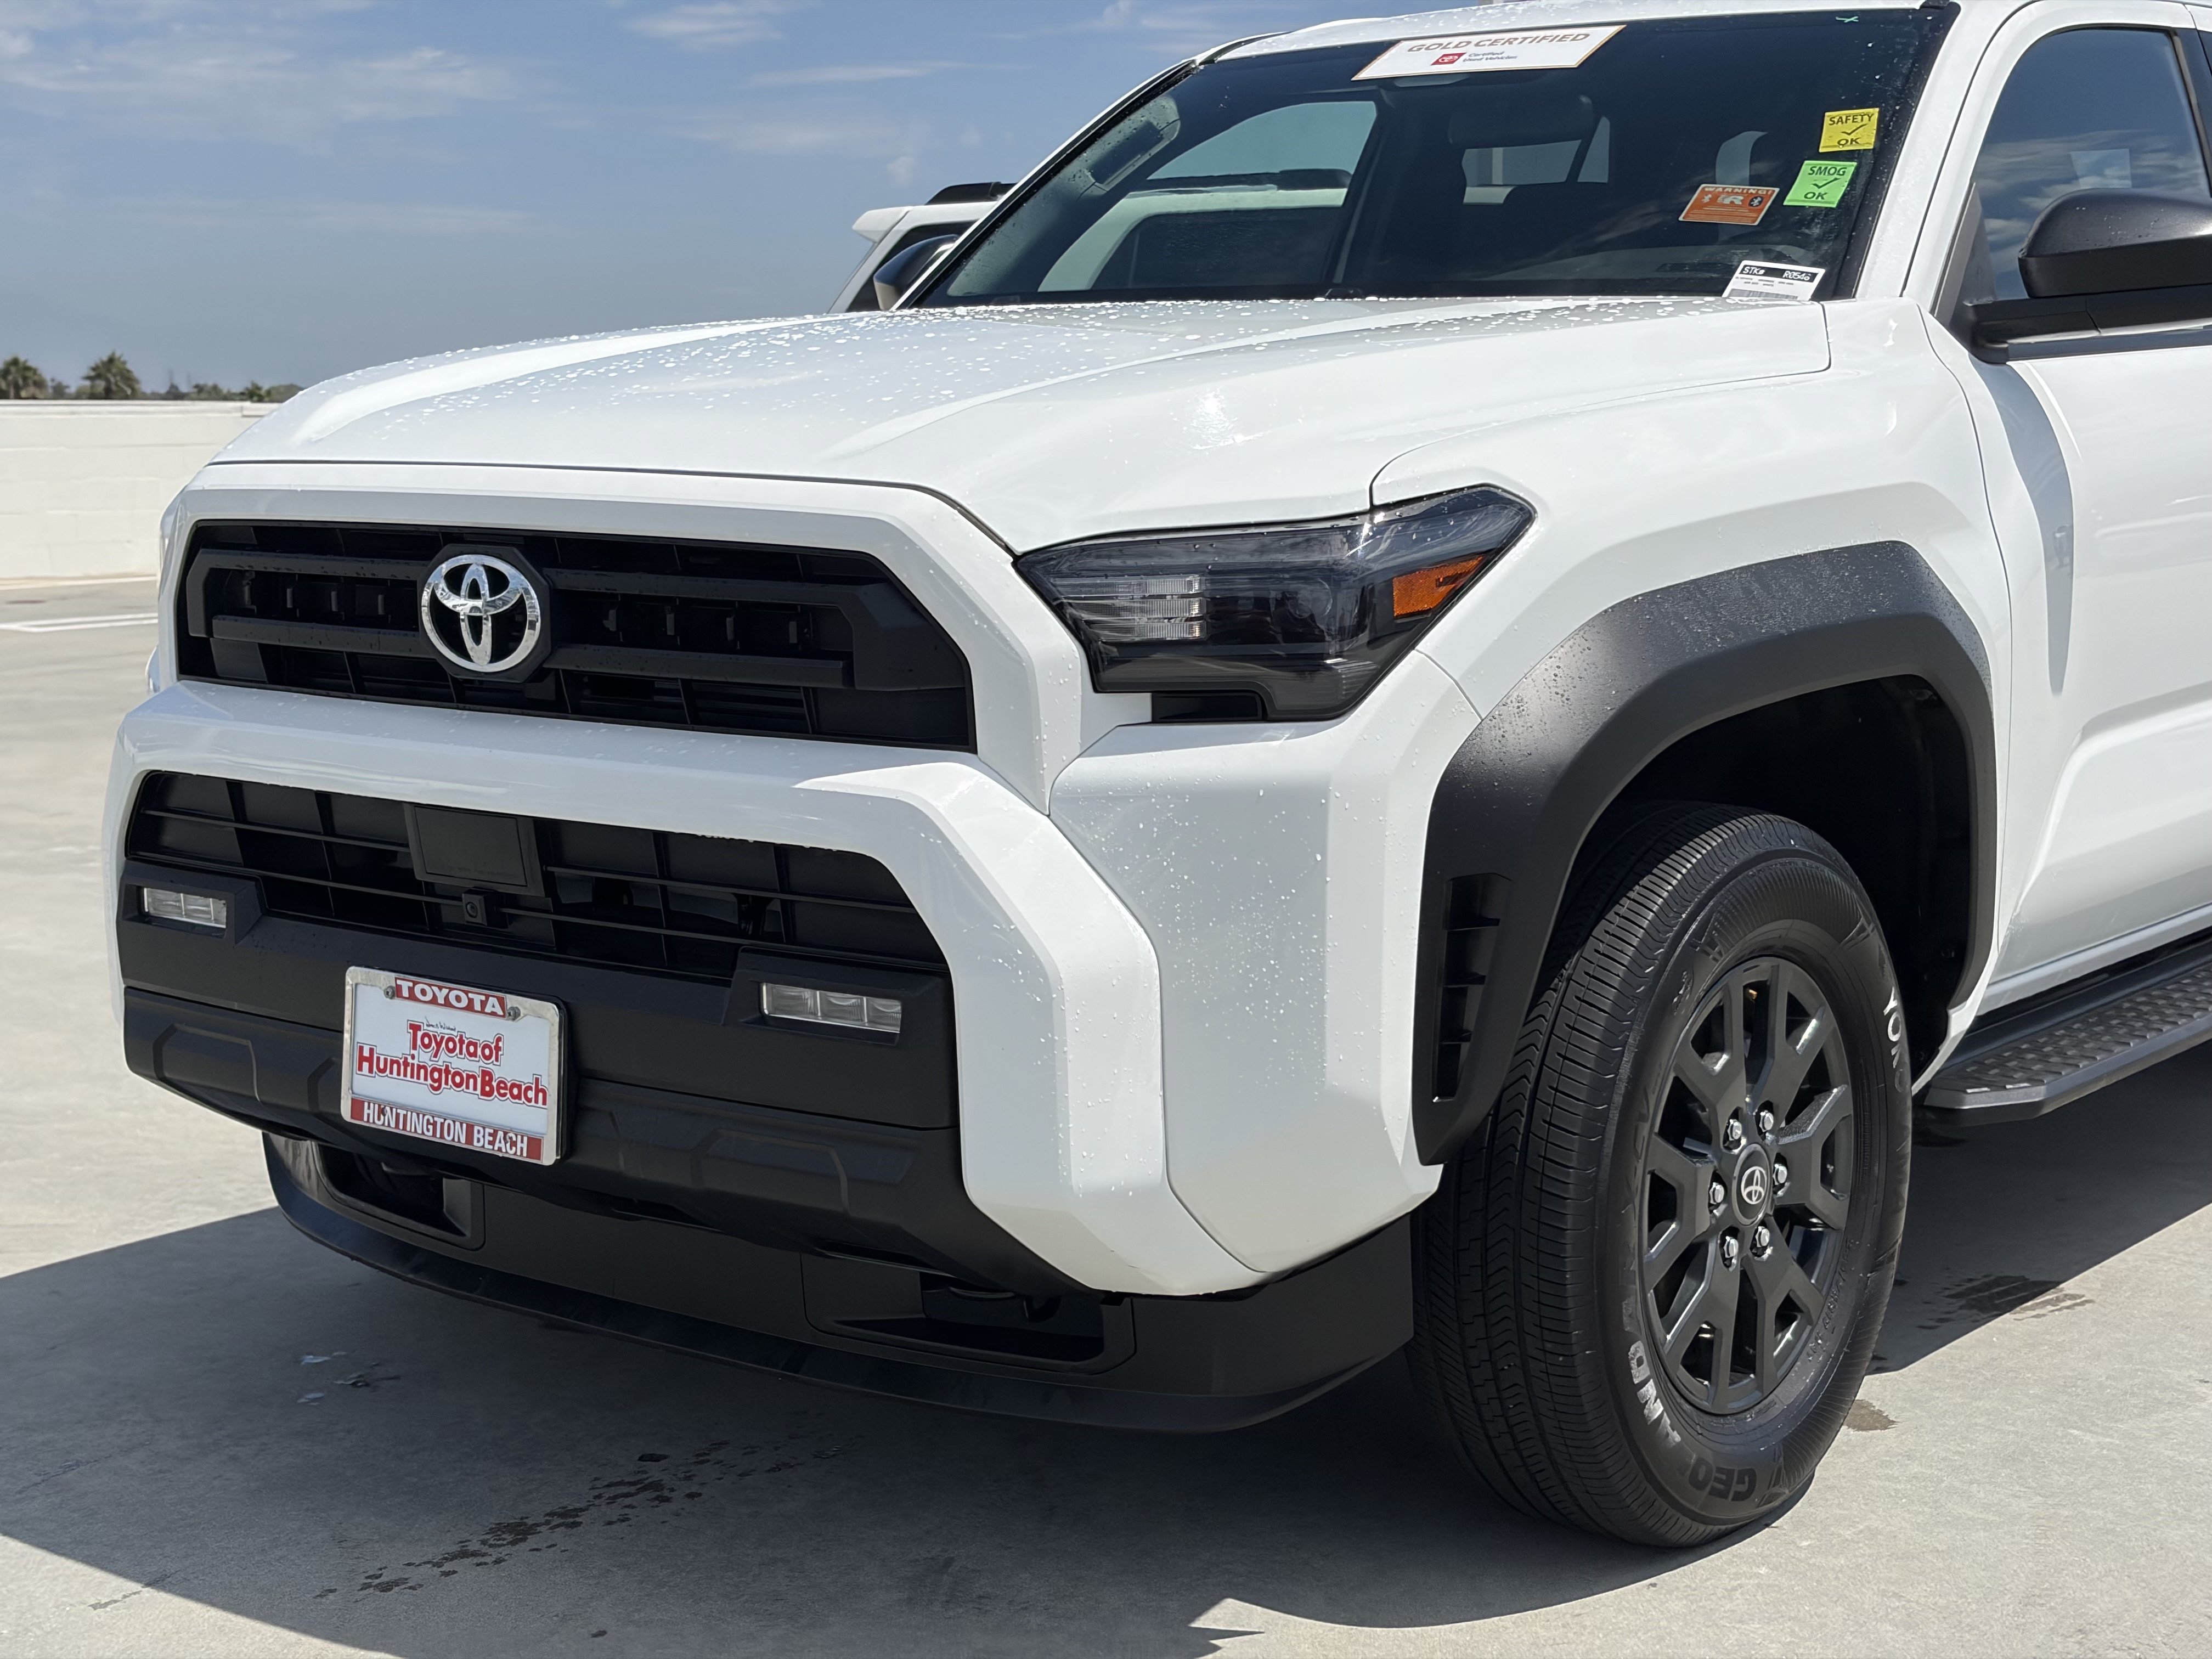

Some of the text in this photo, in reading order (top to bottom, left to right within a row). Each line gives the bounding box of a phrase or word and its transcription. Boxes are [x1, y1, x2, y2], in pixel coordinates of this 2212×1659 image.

[1407, 33, 1590, 52] GOLD CERTIFIED
[1828, 113, 1874, 126] SAFETY
[1837, 137, 1861, 146] OK
[1808, 166, 1848, 176] SMOG
[1704, 187, 1774, 195] WARNING!
[1803, 191, 1829, 200] OK
[396, 979, 504, 1016] TOYOTA
[408, 1020, 478, 1060] Toyota
[363, 1102, 528, 1158] HUNTINGTON BEACH
